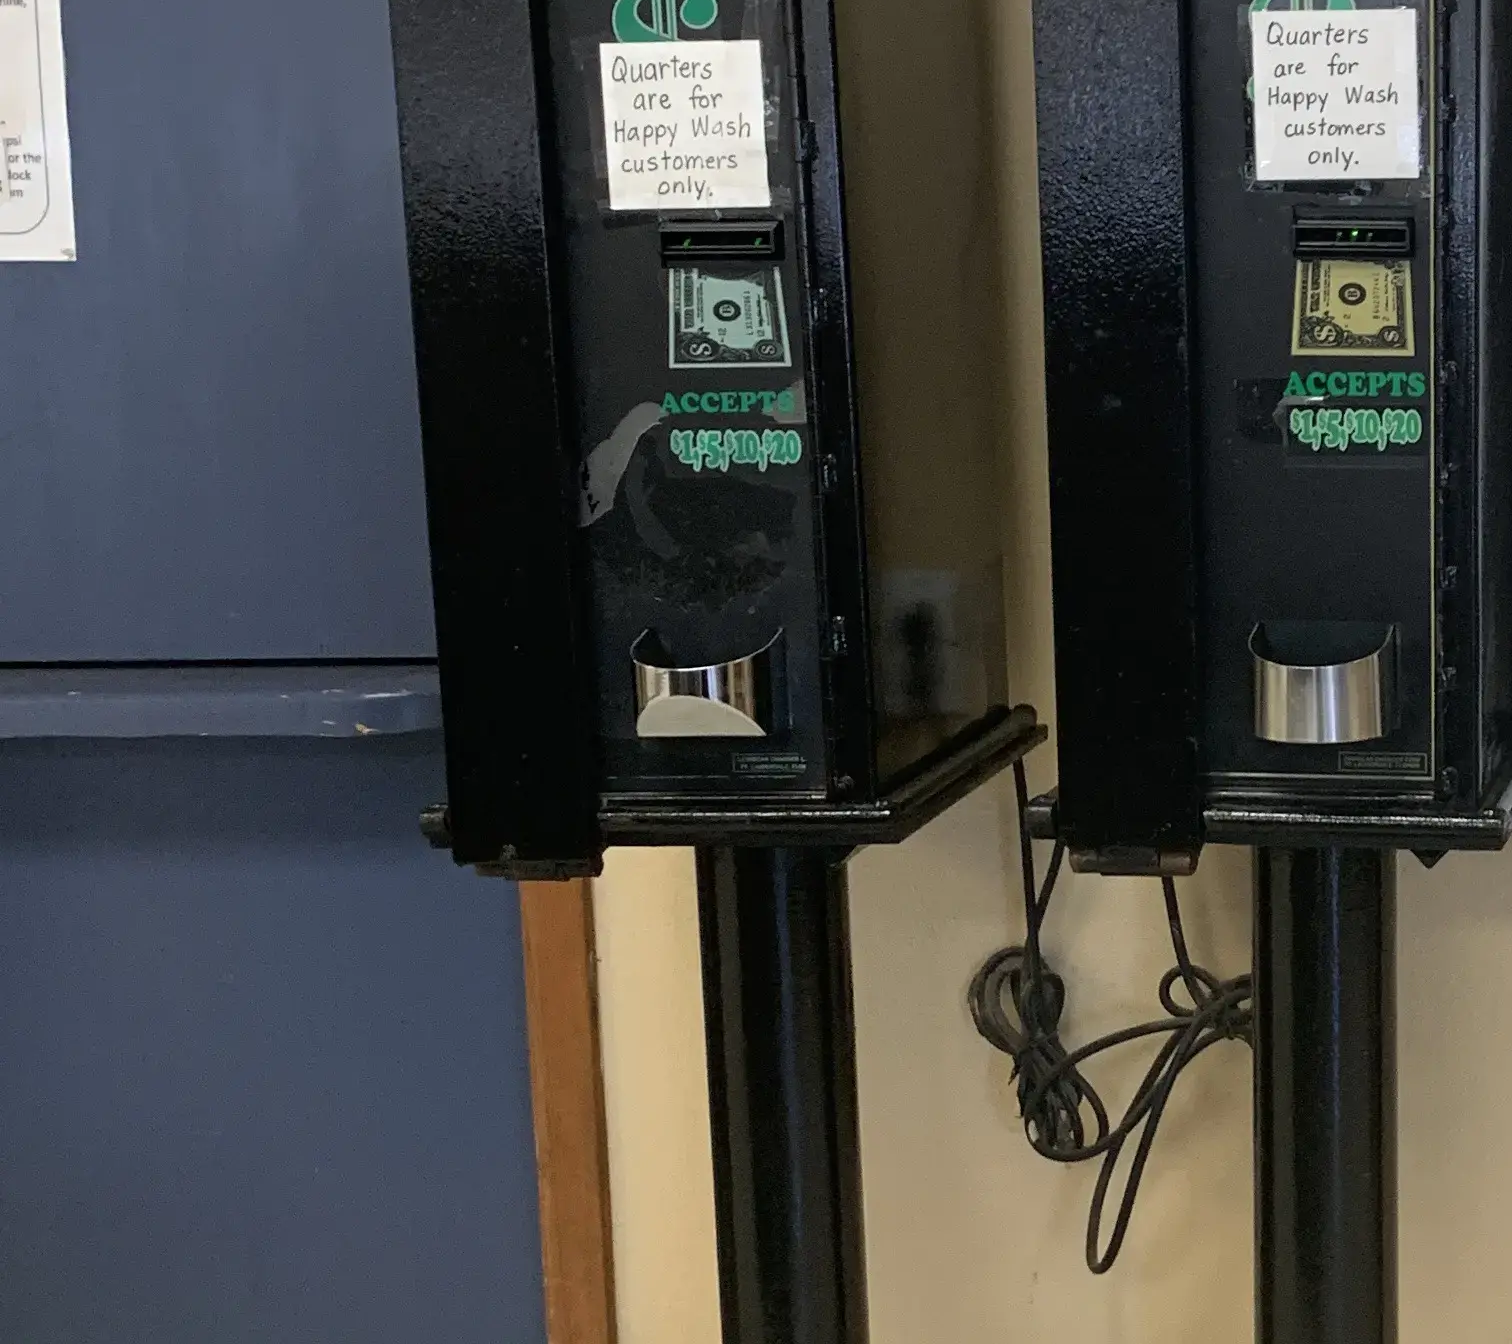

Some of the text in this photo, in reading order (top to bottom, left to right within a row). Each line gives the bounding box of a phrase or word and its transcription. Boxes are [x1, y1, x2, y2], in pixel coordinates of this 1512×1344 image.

[1266, 22, 1369, 47] Quarters
[611, 55, 713, 83] Quarters
[1274, 53, 1360, 78] are for
[633, 85, 723, 111] are for
[1267, 83, 1399, 112] Happy Wash
[613, 113, 751, 147] Happy Wash
[1284, 118, 1386, 138] customers
[620, 150, 738, 173] customers
[1307, 148, 1360, 170] only.
[657, 177, 714, 199] only.
[1284, 371, 1425, 397] ACCEPTS
[660, 391, 795, 413] ACCEPTS
